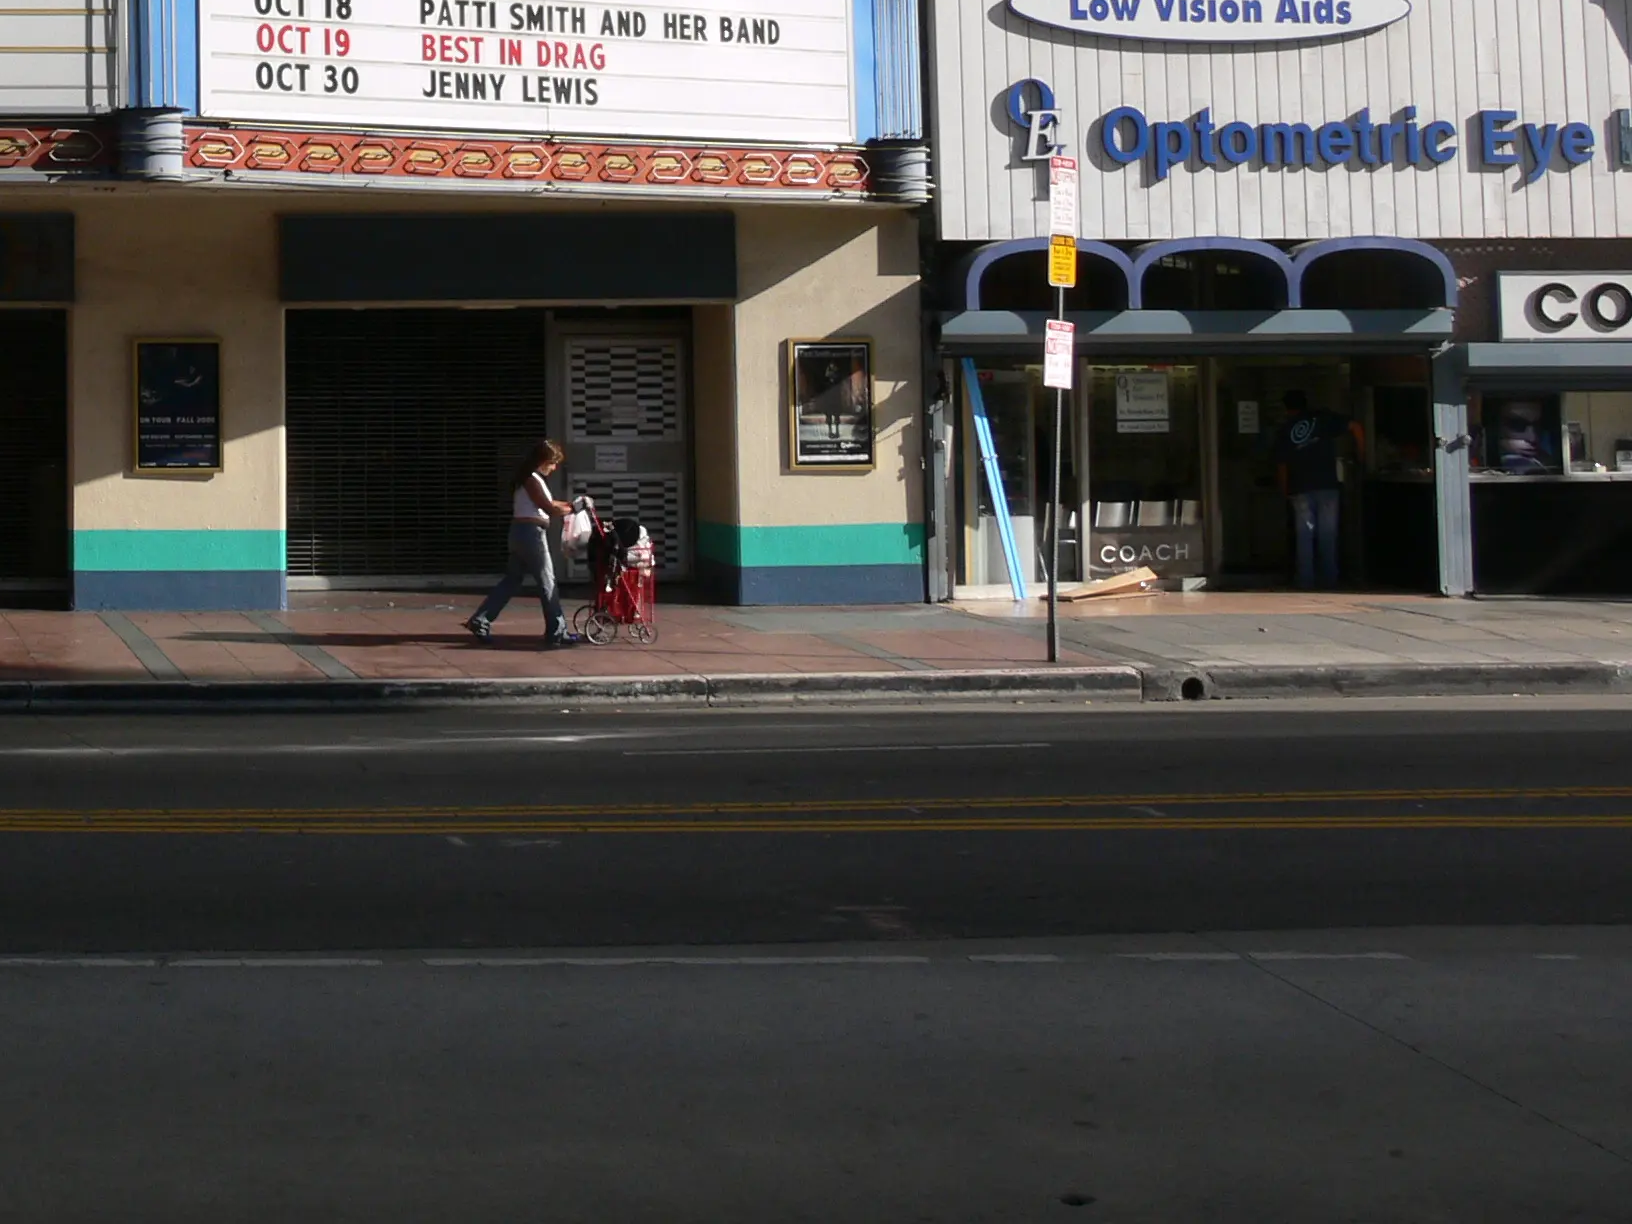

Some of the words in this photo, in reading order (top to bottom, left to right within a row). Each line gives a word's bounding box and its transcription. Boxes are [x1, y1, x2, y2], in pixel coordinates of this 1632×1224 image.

[509, 2, 586, 34] SMITH
[600, 9, 647, 38] AND
[663, 12, 708, 42] HER
[719, 16, 780, 45] BAND
[256, 23, 310, 55] OCT
[324, 28, 351, 57] 19
[421, 34, 484, 64] BEST
[499, 38, 522, 66] IN
[536, 40, 606, 71] DRAG
[255, 62, 310, 92] OCT
[323, 65, 359, 94] 30
[422, 70, 506, 102] JENNY
[522, 75, 599, 106] LEWIS
[1102, 105, 1458, 180] Optometric
[1479, 109, 1596, 185] Eye
[1532, 282, 1632, 329] CO
[1100, 543, 1190, 564] COACH
